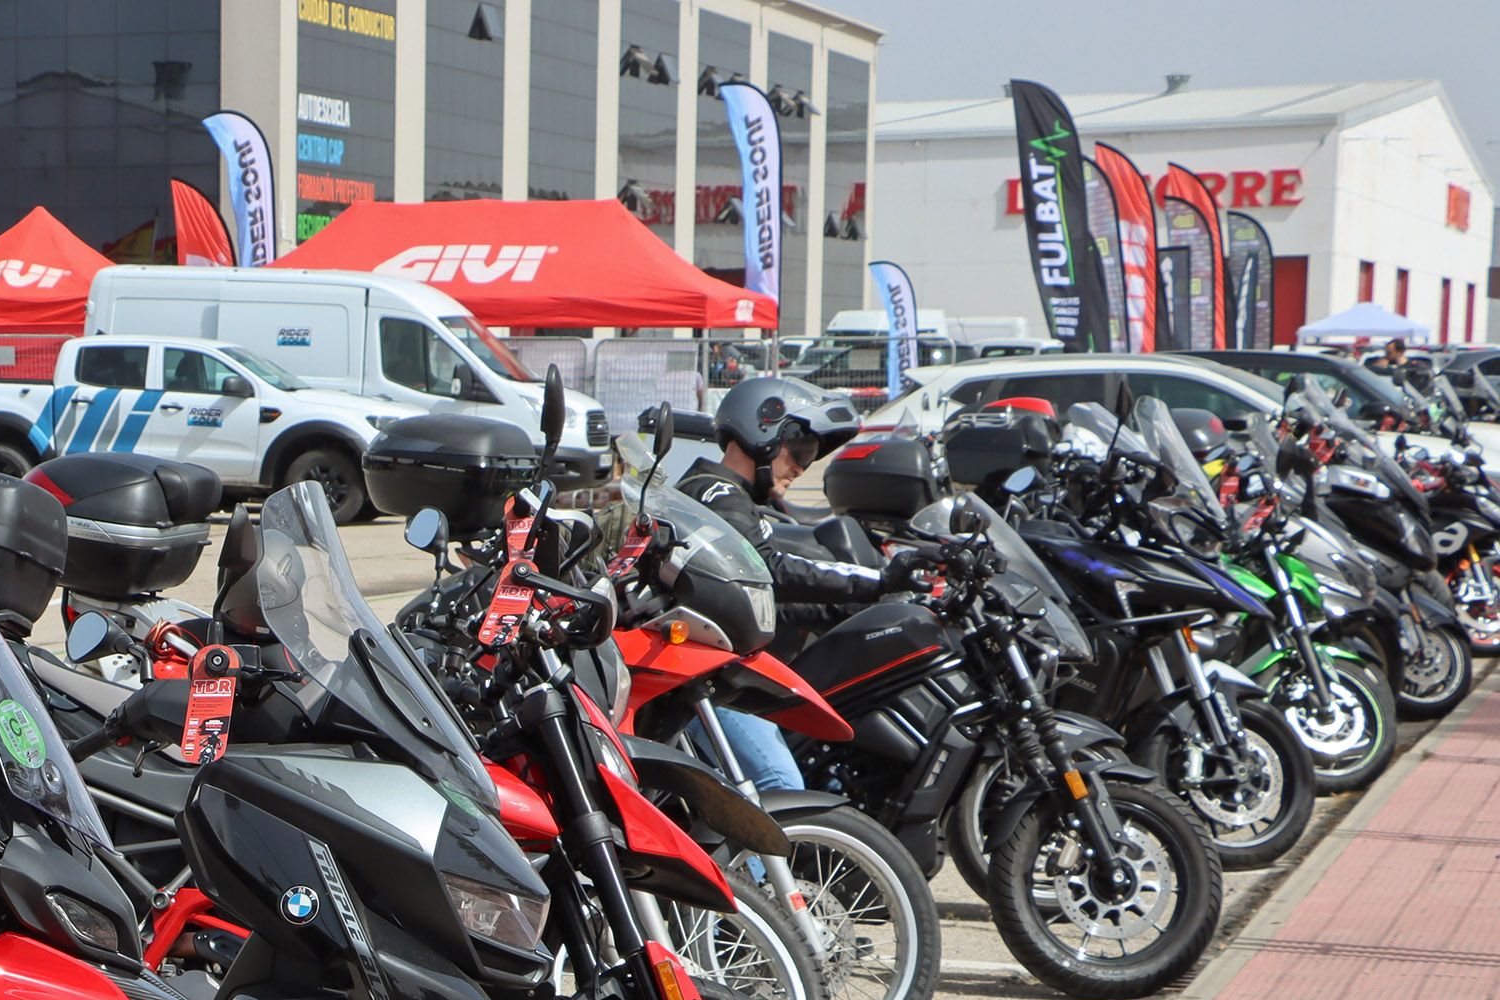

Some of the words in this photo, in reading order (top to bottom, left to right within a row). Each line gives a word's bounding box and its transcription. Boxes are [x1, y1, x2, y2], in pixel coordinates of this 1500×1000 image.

[331, 1, 347, 30] DEL
[348, 6, 395, 41] CONDUCTOR
[297, 92, 351, 128] AUTOESCUELA
[297, 133, 327, 163] CENTRO
[328, 138, 344, 165] CAP
[1029, 158, 1071, 287] FULBAT
[370, 245, 548, 284] GIVI
[279, 328, 310, 337] RIDER
[280, 337, 308, 345] SOUL
[190, 407, 223, 417] RIDER
[192, 417, 219, 426] SOUL
[500, 585, 531, 597] TDR
[194, 679, 232, 694] TDR
[285, 886, 318, 901] BMW
[315, 850, 365, 943] TRIPLE
